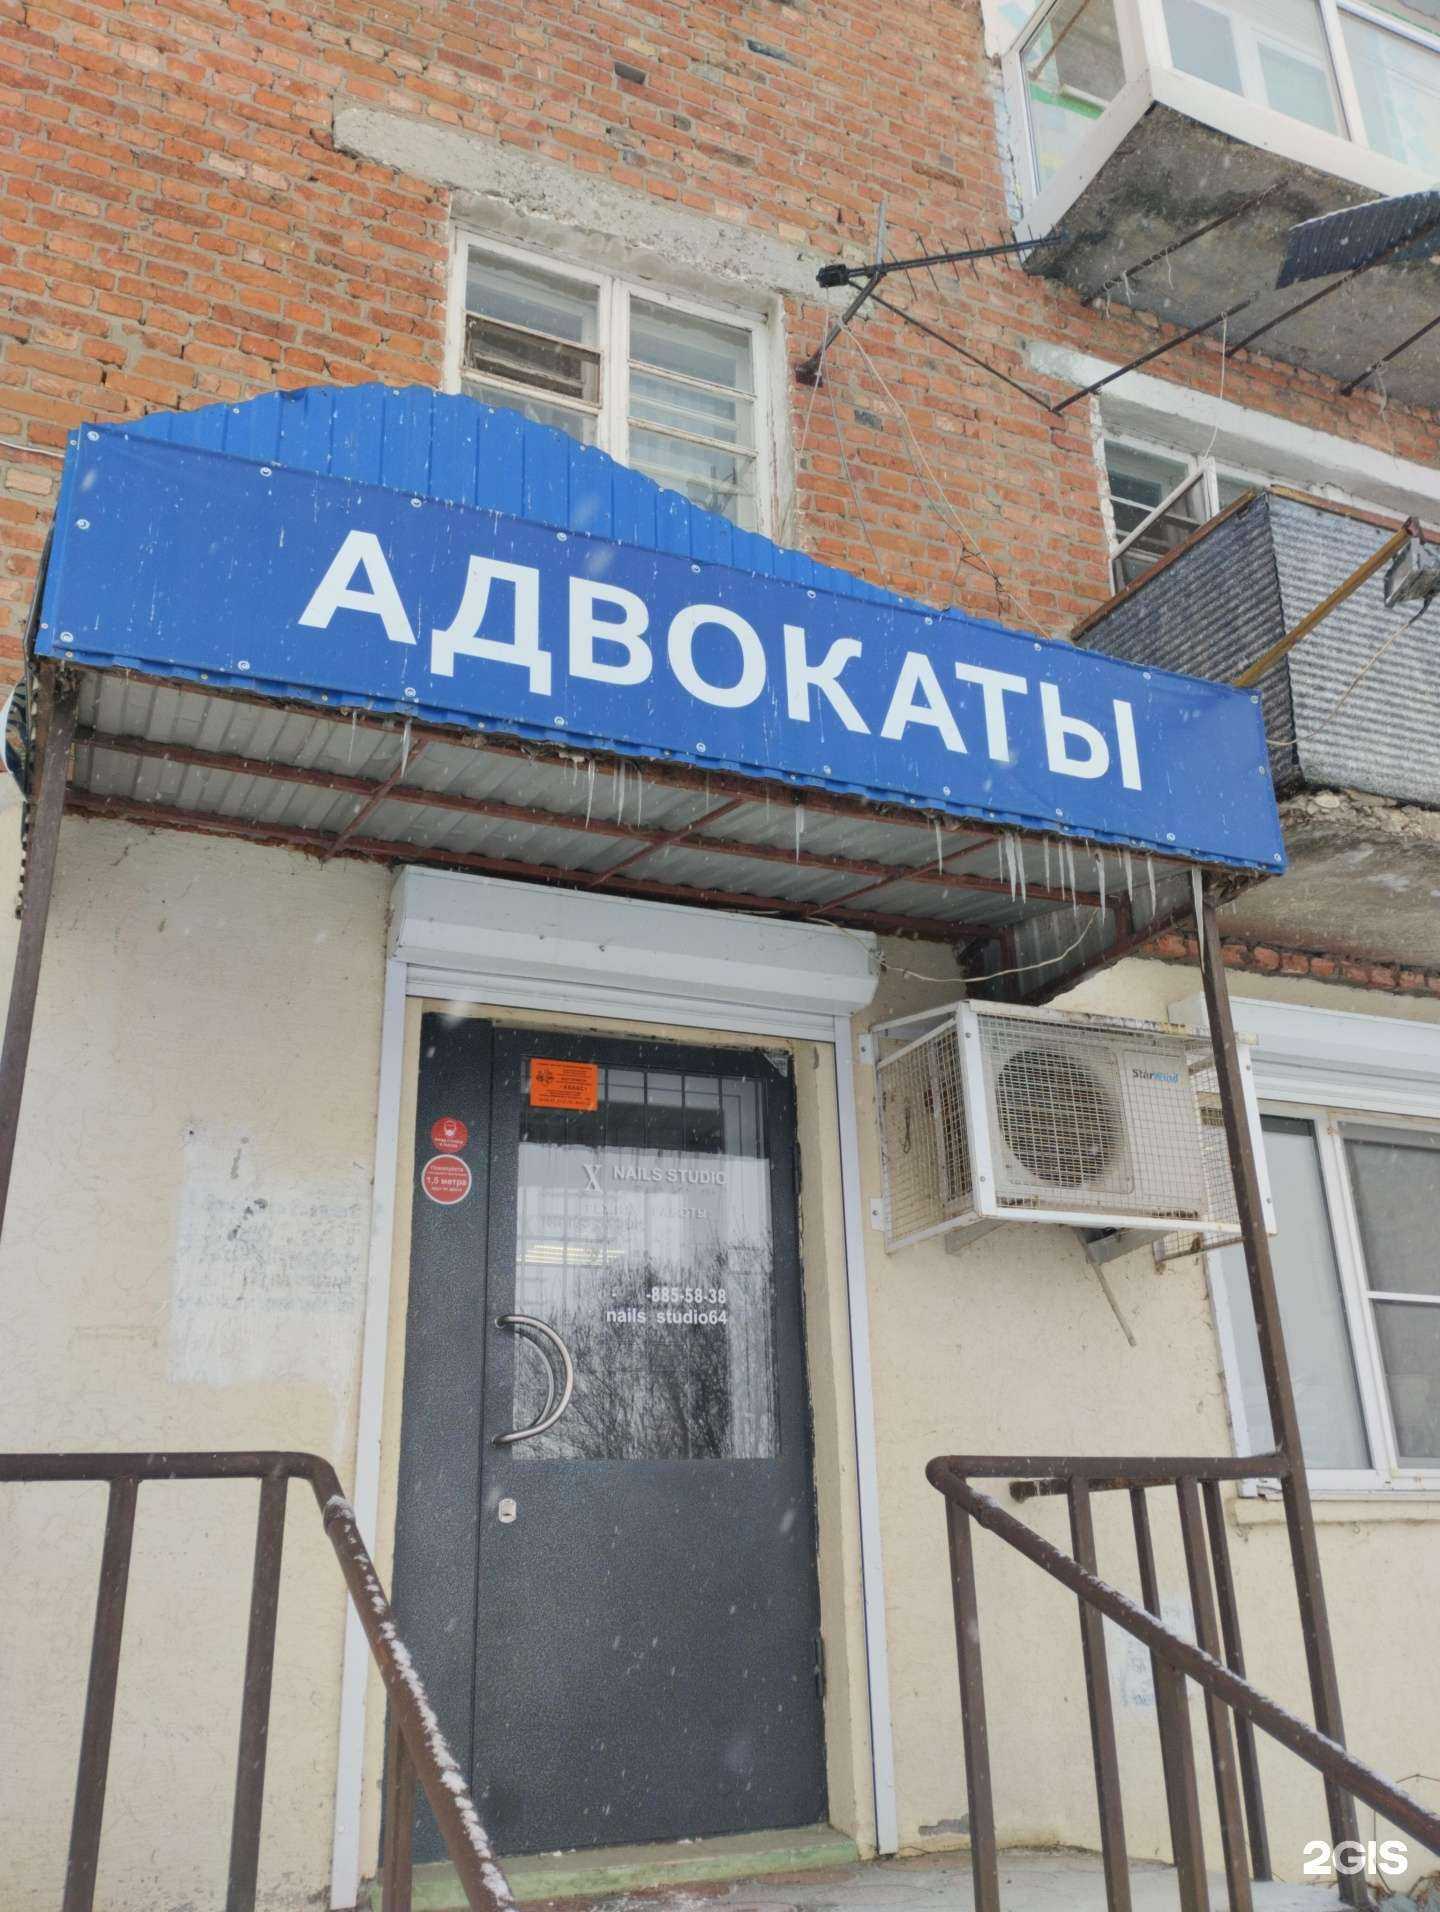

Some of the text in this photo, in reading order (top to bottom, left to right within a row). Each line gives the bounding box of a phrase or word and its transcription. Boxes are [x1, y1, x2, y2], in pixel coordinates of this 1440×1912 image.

[298, 530, 1142, 792] АДВОКАТЫ
[582, 1164, 728, 1193] X NAILS STUDIO
[606, 1308, 728, 1325] nails studio64
